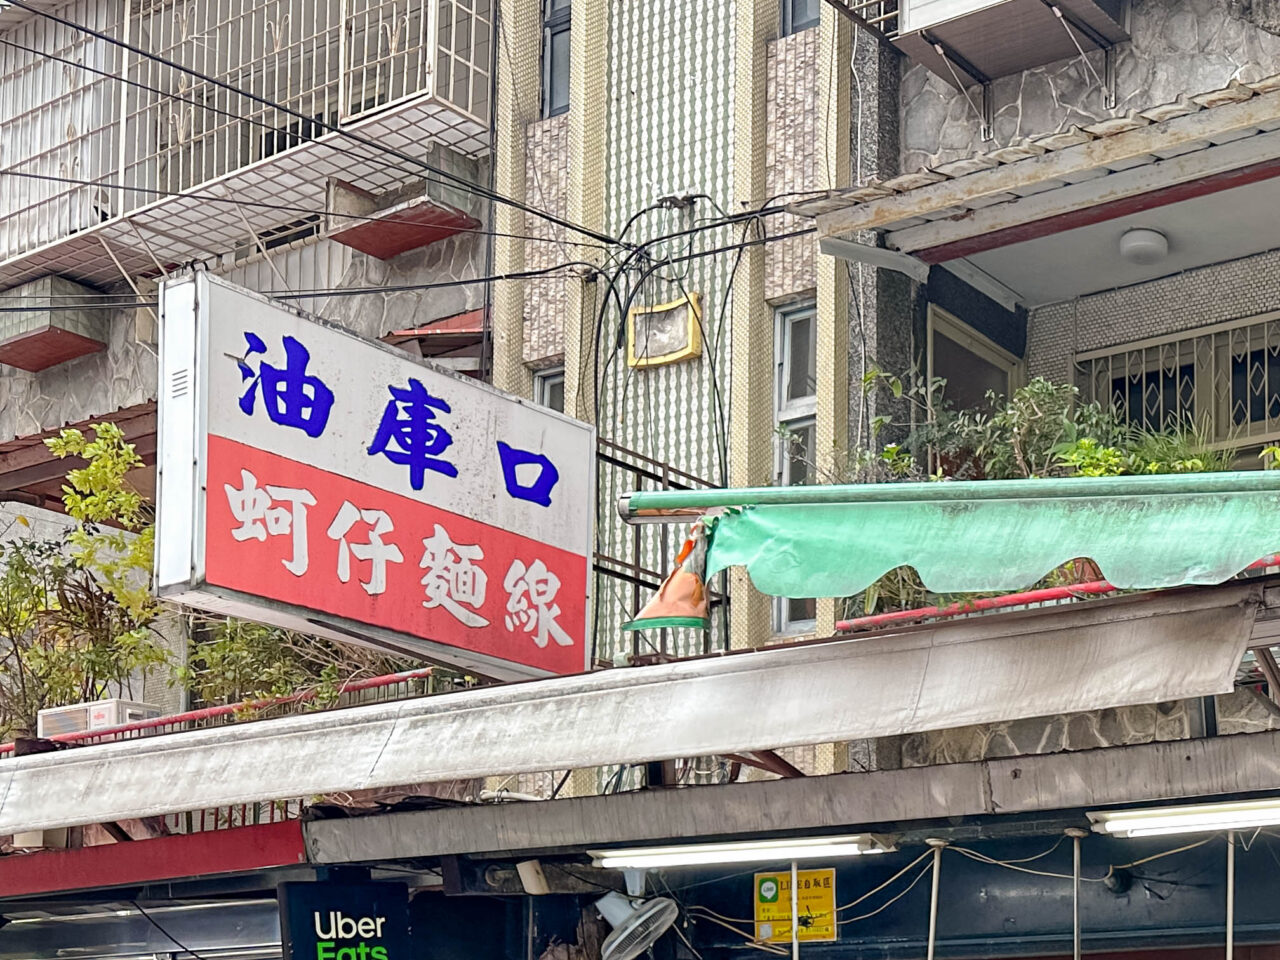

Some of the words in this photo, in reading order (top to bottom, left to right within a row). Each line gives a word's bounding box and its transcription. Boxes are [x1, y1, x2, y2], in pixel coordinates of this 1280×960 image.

[238, 331, 559, 506] 油庫口
[224, 468, 574, 648] 蚵仔麵線
[314, 911, 386, 939] Uber
